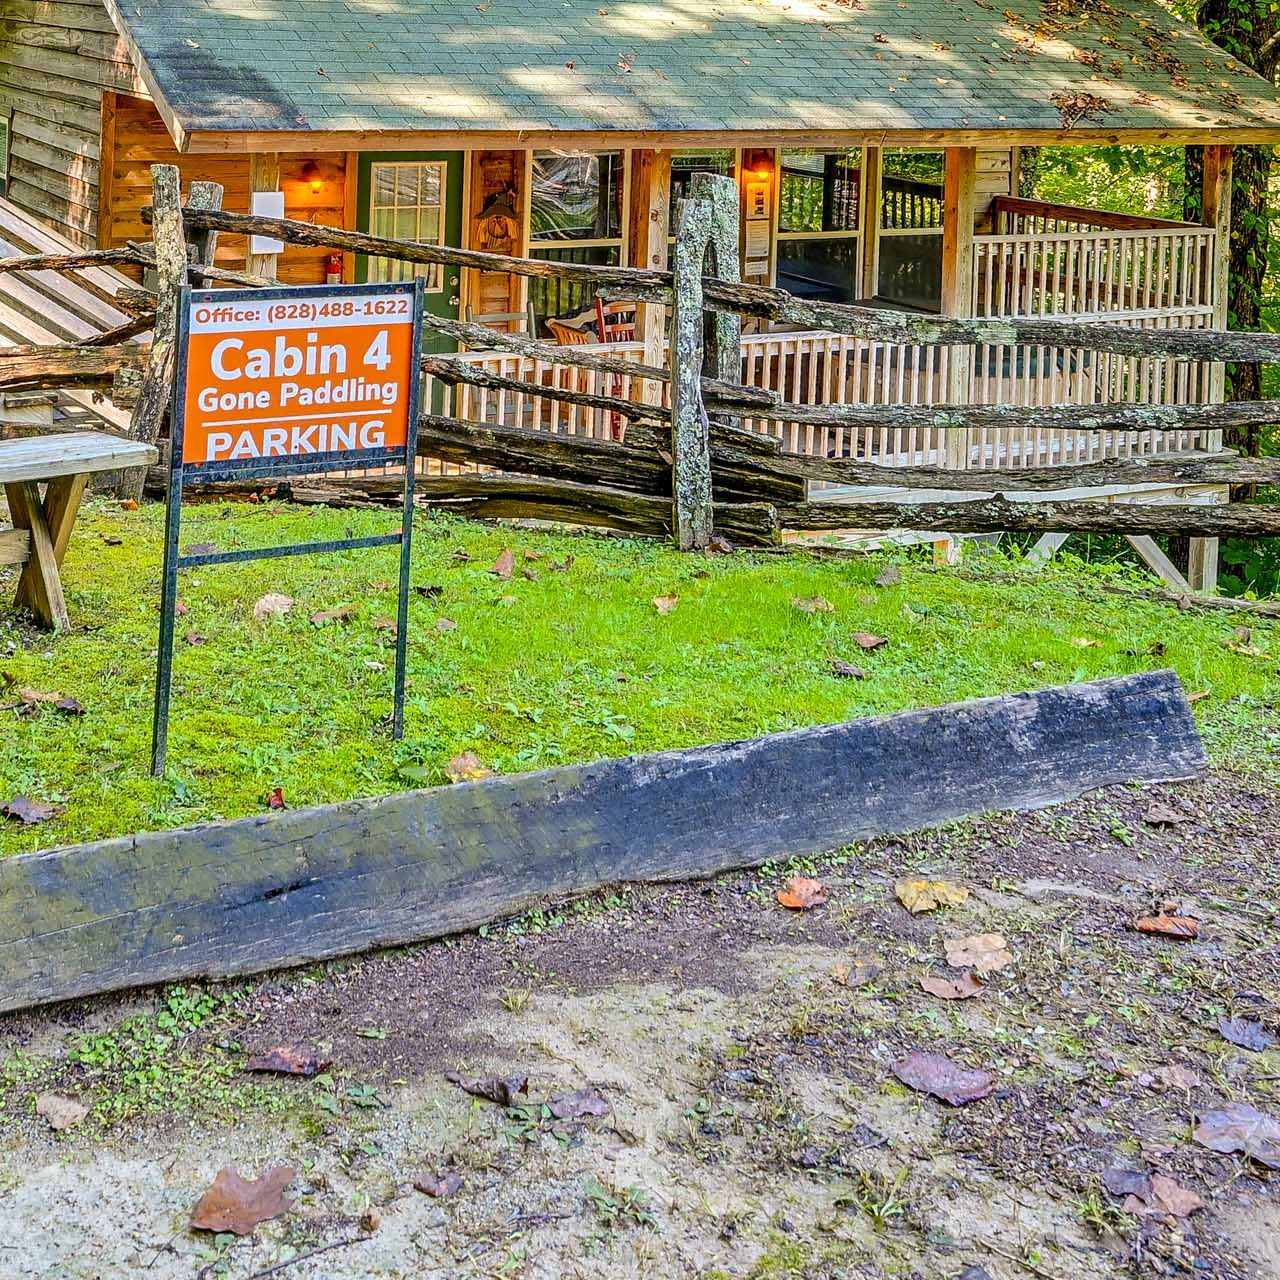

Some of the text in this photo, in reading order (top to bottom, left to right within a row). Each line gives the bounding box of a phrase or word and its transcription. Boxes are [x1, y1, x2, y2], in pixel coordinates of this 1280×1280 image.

[195, 299, 409, 324] Office: (828)488-1622
[210, 329, 392, 381] Cabin 4
[197, 377, 398, 412] Gone Paddling
[206, 420, 385, 462] PARKING
